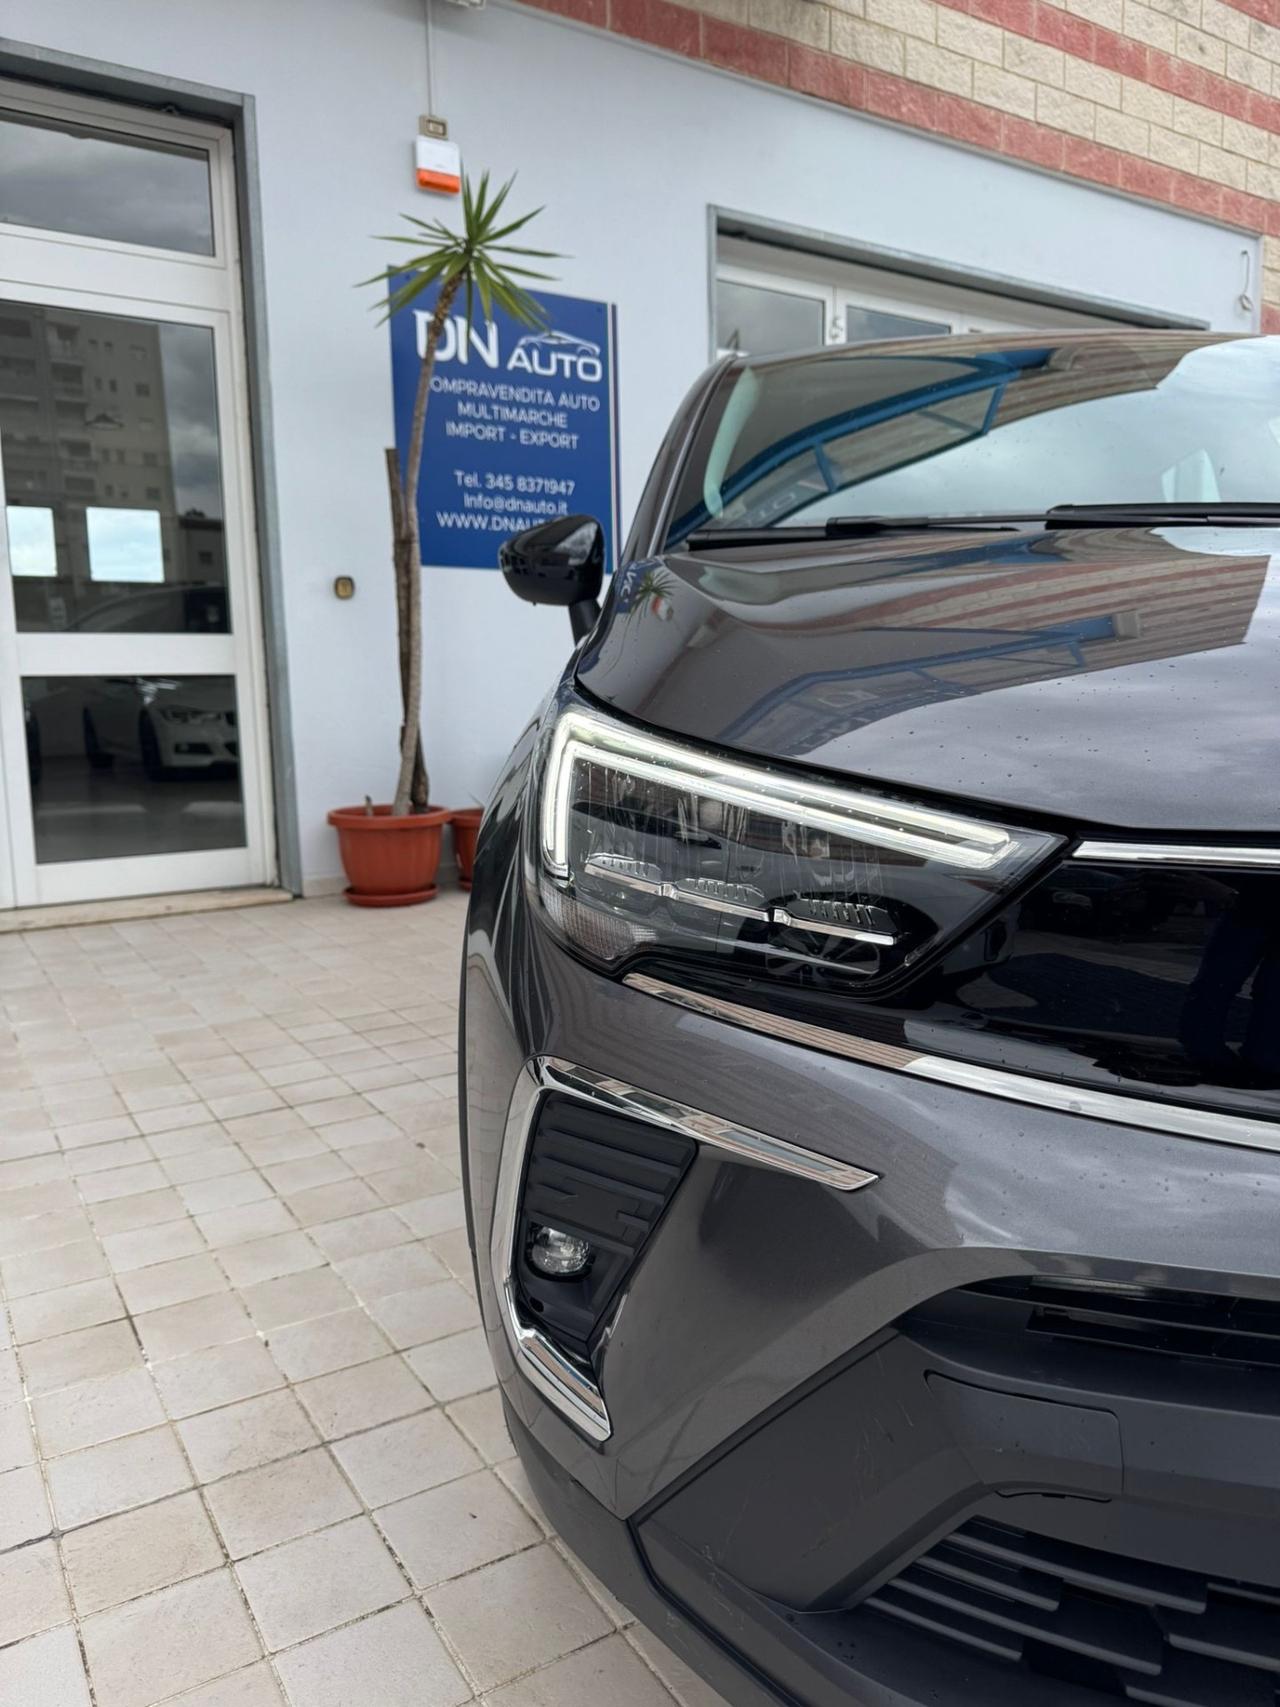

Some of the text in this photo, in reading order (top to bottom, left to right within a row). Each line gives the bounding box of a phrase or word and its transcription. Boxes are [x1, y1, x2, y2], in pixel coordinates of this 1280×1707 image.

[413, 309, 603, 383] DN AUTO
[430, 375, 601, 412] OMPRAVENDITA AUTO
[457, 401, 568, 428] MULTIMARCHE
[445, 421, 506, 442] IMPORT
[520, 428, 579, 449] EXPORT
[454, 469, 576, 497] Tel. 345 8371947
